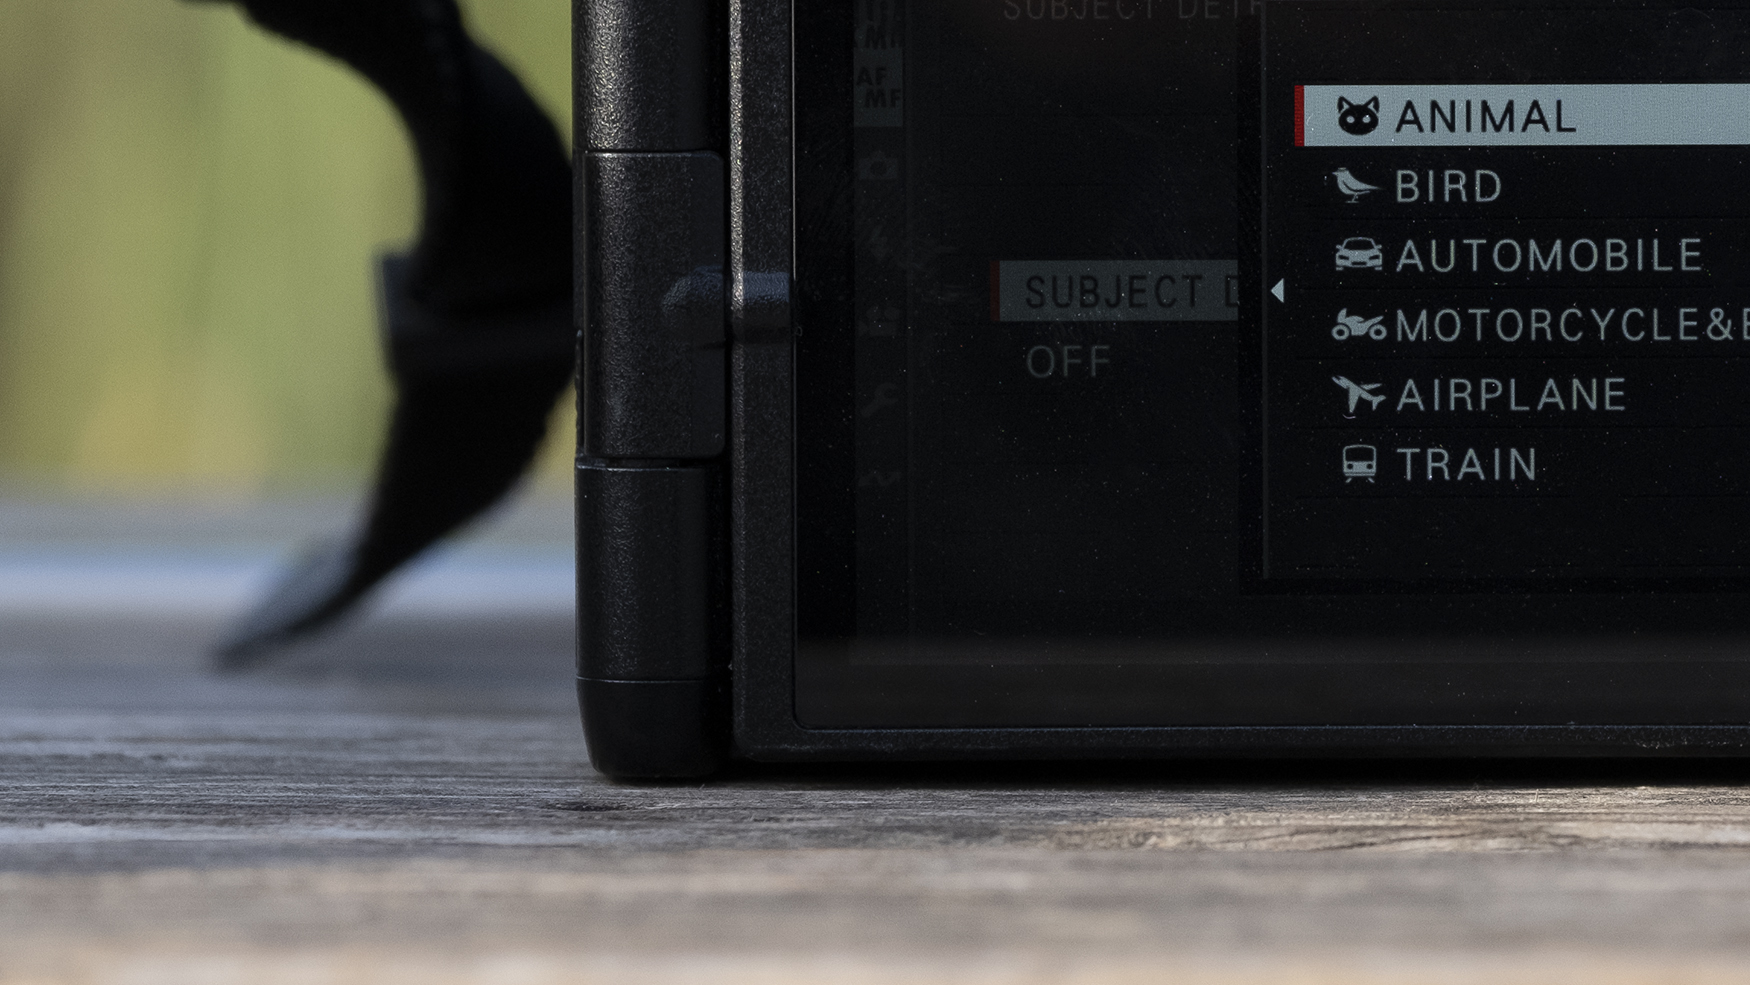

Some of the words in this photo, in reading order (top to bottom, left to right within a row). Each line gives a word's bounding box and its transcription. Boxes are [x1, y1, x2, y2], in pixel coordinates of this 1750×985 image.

[1395, 98, 1577, 133] ANIMAL
[1395, 169, 1502, 203] BIRD
[1395, 238, 1703, 272] AUTOMOBILE
[1025, 274, 1203, 309] SUBJECT
[1025, 344, 1111, 379] OFF
[1395, 377, 1627, 412] AIRPLANE
[1396, 447, 1537, 482] TRAIN
